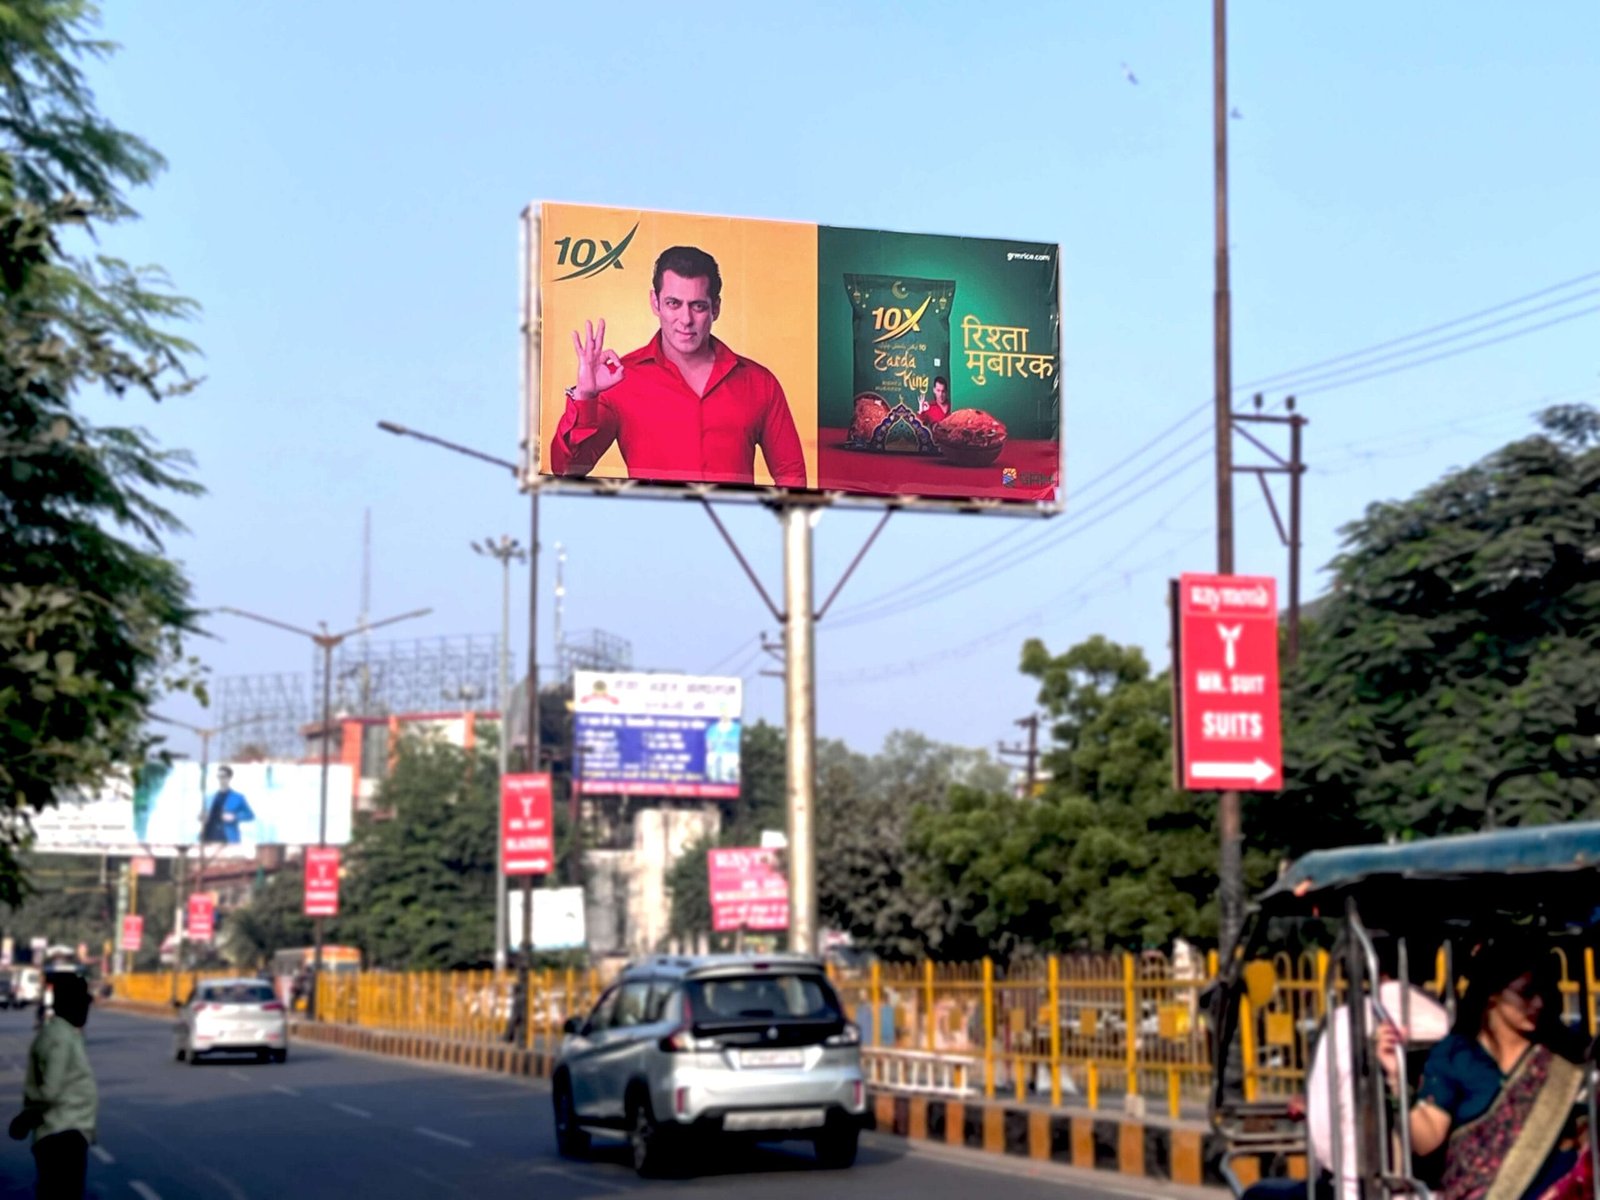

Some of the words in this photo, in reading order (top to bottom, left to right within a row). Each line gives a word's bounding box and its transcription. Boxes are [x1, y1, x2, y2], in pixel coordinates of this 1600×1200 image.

[552, 221, 640, 282] 10X
[871, 295, 932, 343] 10X
[961, 315, 1029, 352] रिश्ता
[874, 349, 917, 372] Zarda
[963, 350, 1055, 385] मुबारक
[894, 370, 929, 394] King
[1196, 671, 1228, 693] MR.
[1230, 674, 1265, 695] SUIT
[1202, 710, 1264, 739] SUITS
